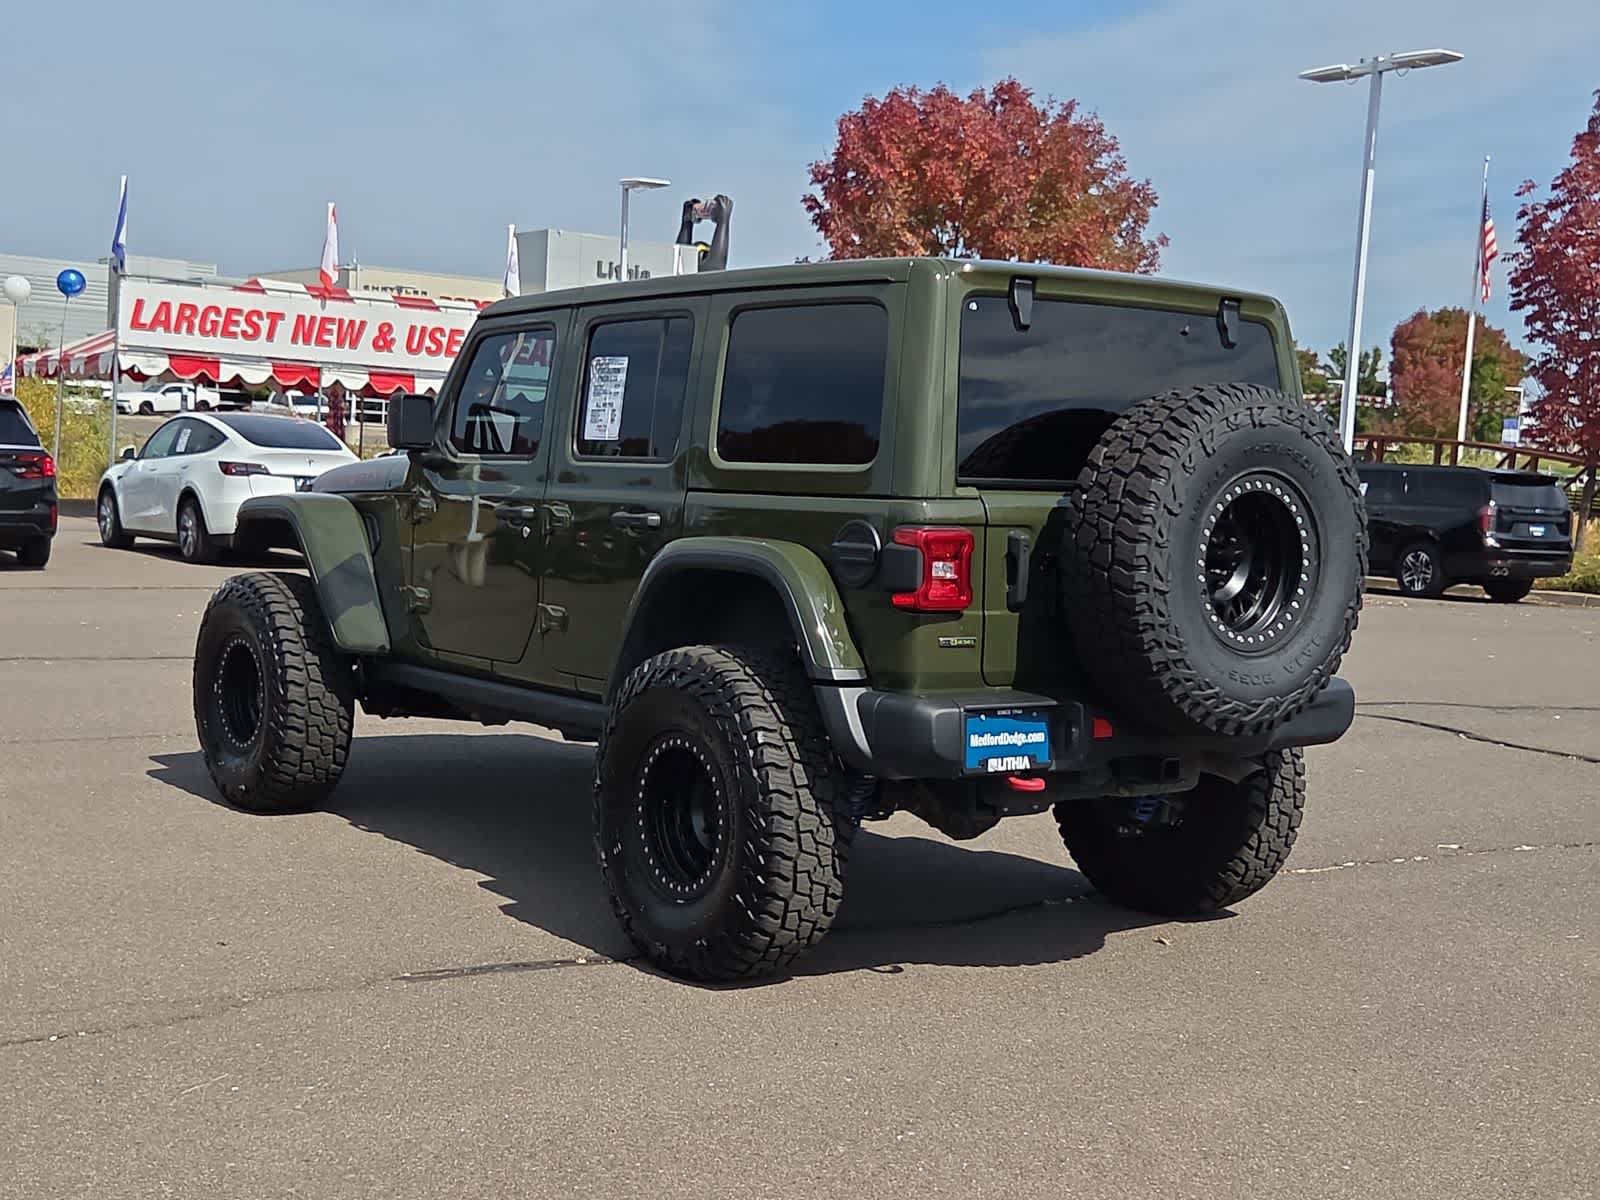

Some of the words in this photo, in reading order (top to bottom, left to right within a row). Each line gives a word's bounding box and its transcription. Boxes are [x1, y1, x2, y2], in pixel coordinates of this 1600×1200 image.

[130, 298, 286, 342] LARGEST
[291, 314, 367, 349] NEW
[372, 323, 396, 352] &
[406, 325, 465, 358] USE
[970, 732, 1045, 747] MedfordDodge.com
[998, 755, 1031, 772] LITHIA
